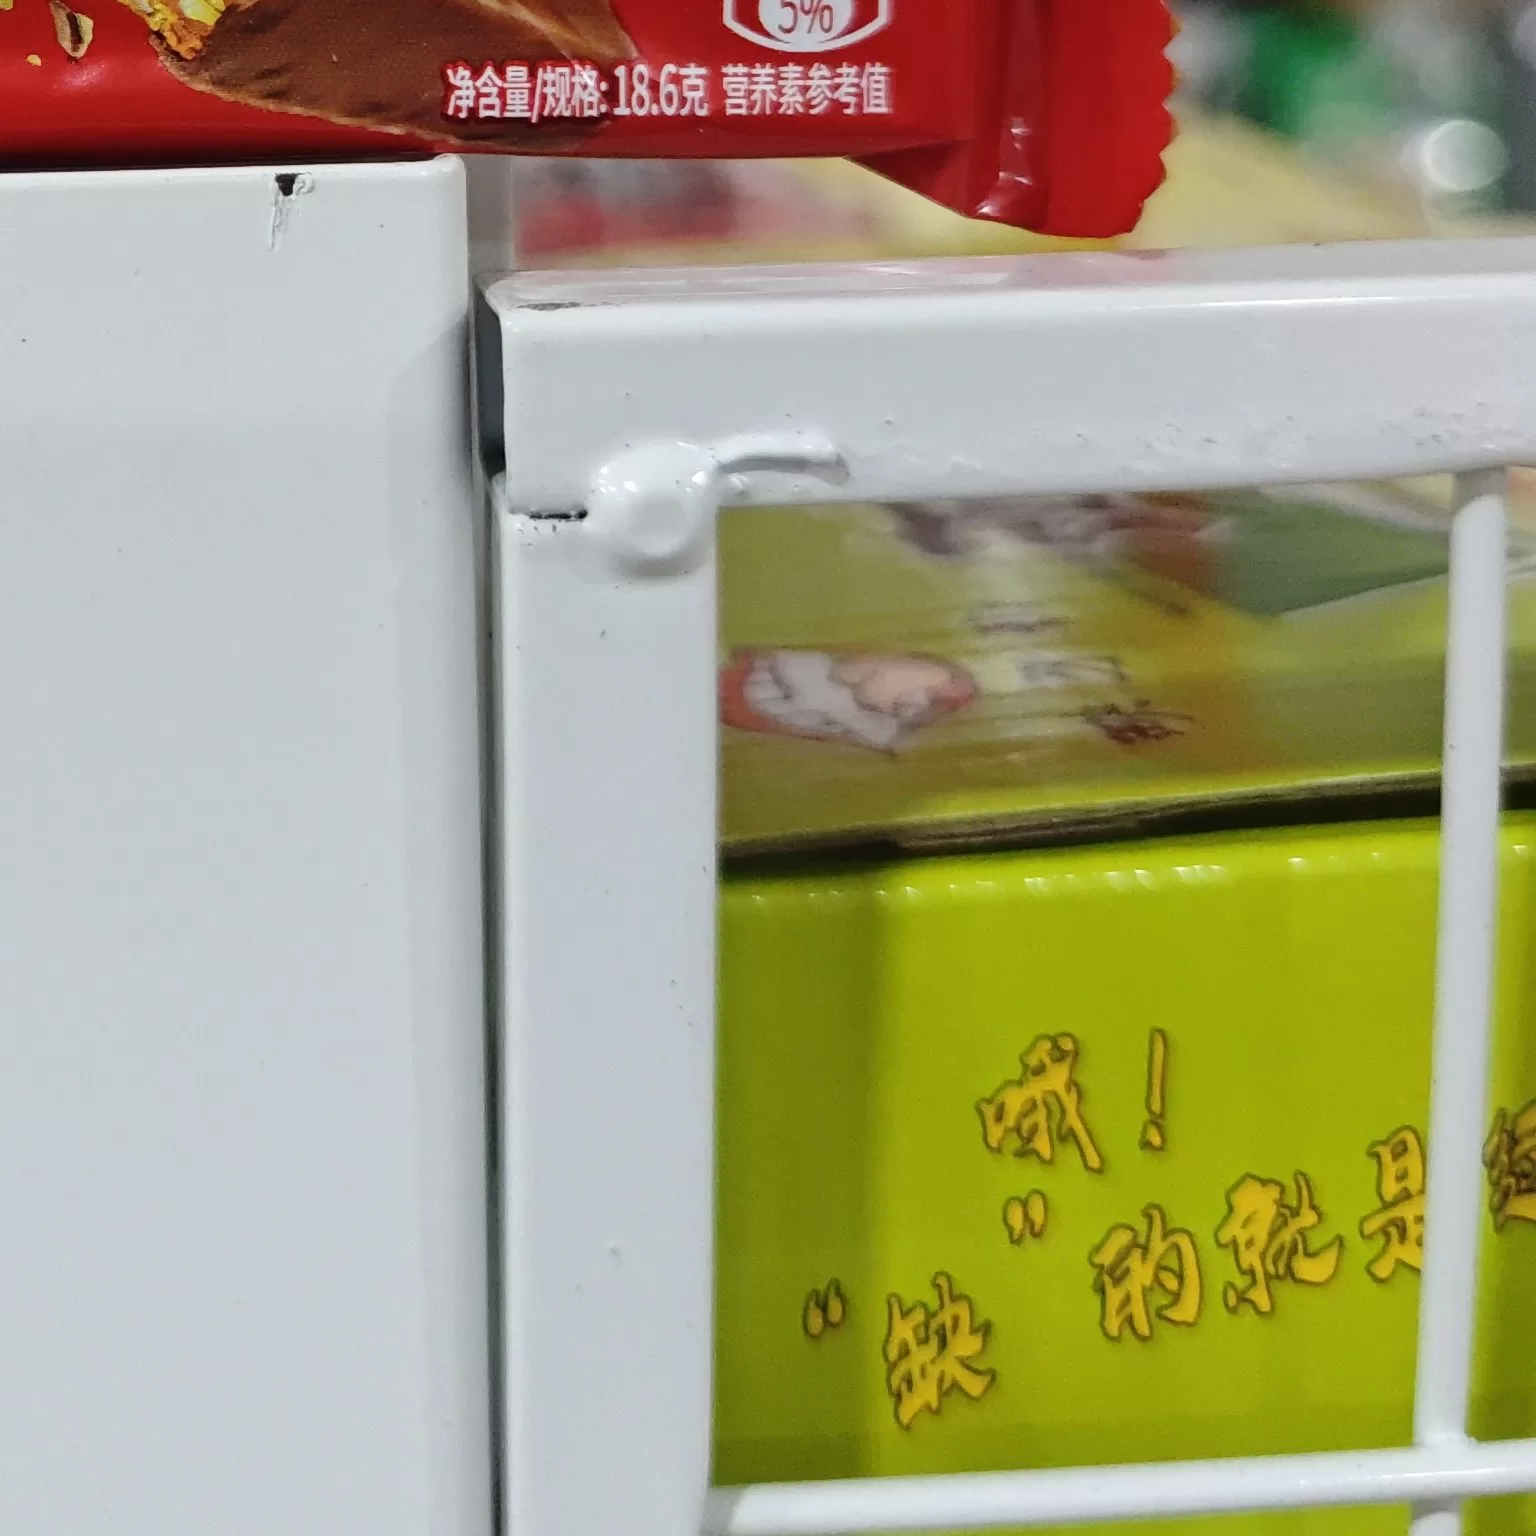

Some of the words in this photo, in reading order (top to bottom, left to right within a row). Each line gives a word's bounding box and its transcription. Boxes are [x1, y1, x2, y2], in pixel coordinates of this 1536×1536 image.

[721, 63, 894, 116] 营养素参考值
